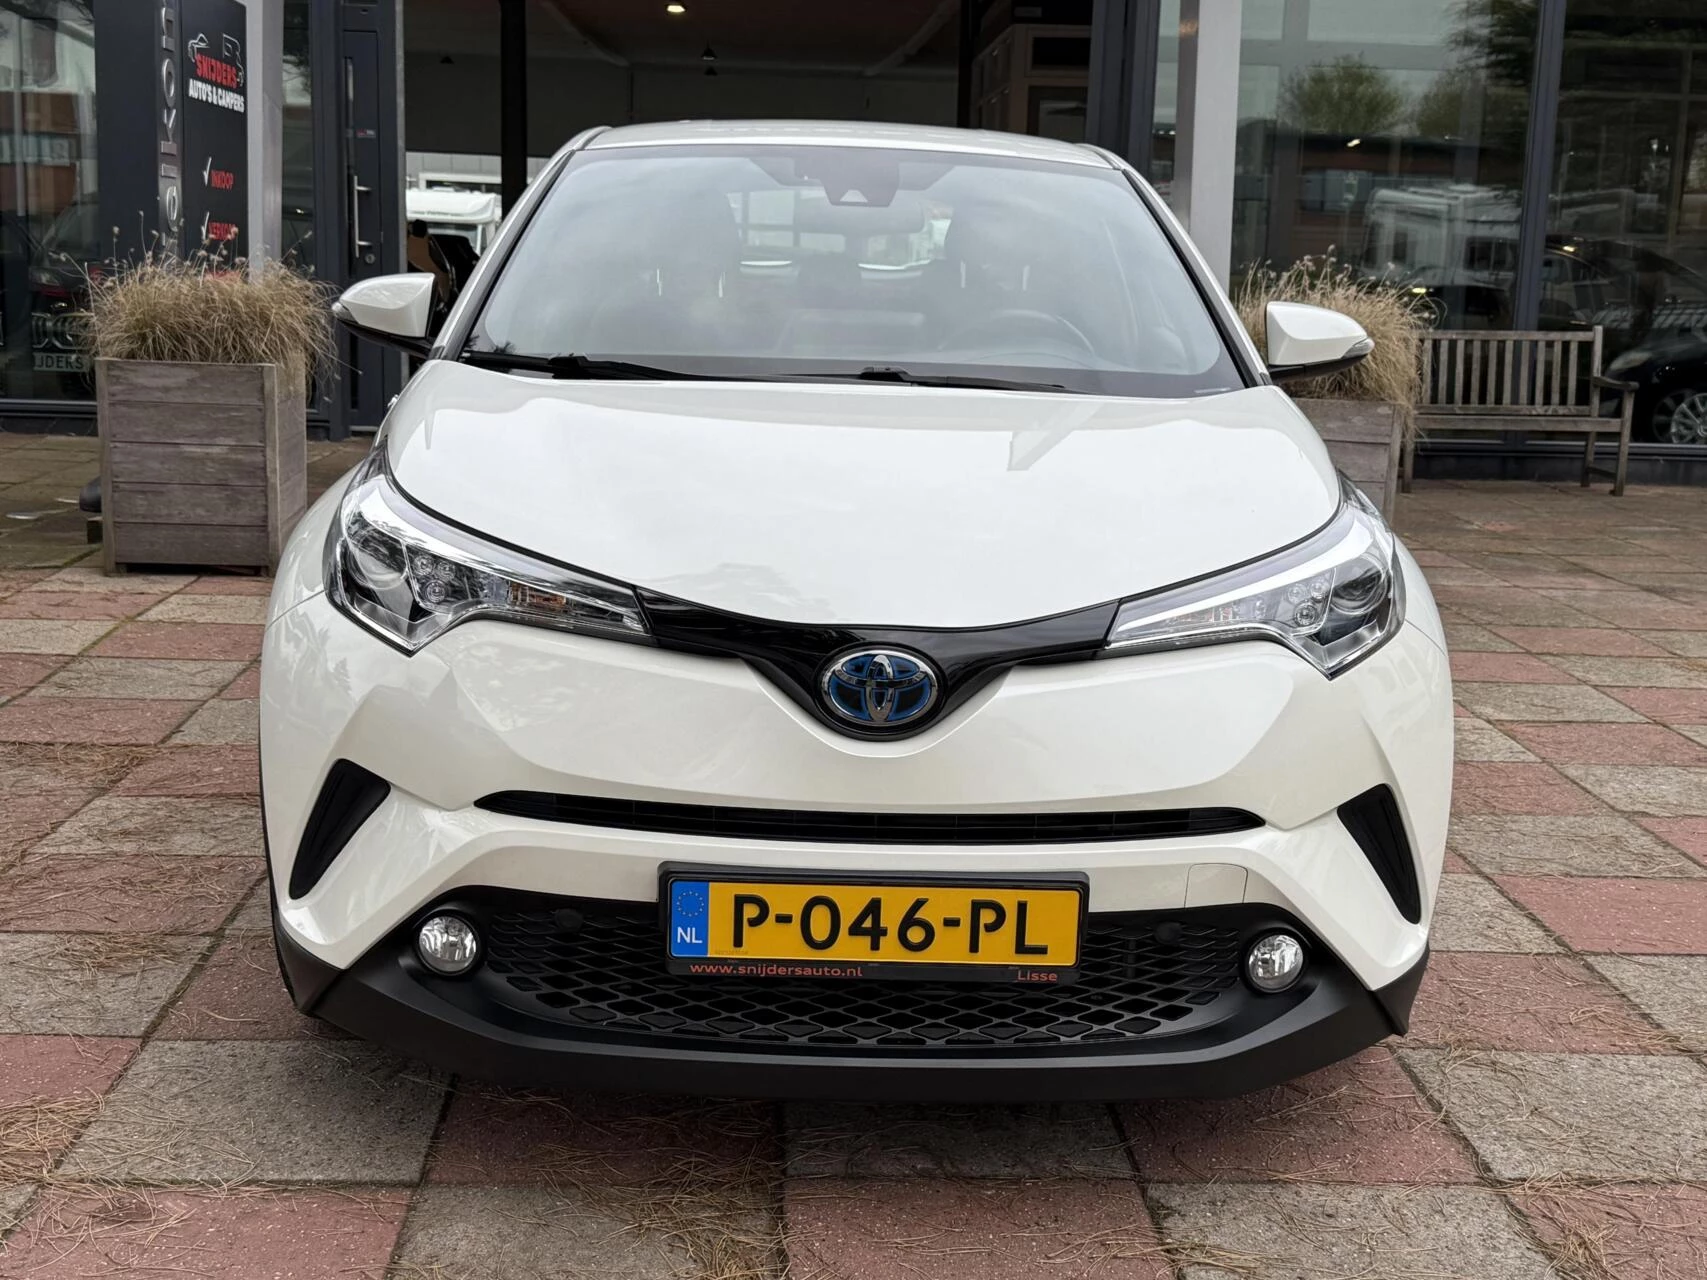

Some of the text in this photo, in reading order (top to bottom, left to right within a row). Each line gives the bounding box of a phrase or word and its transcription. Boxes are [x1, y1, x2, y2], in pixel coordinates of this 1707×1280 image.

[195, 53, 237, 89] SNIJDERS
[188, 78, 212, 103] AUTO'S
[218, 87, 245, 113] CAMPERS
[677, 926, 703, 944] NL
[733, 893, 1049, 955] P-046-PL
[690, 963, 1058, 981] www.snijdersauto.nl Lisse
